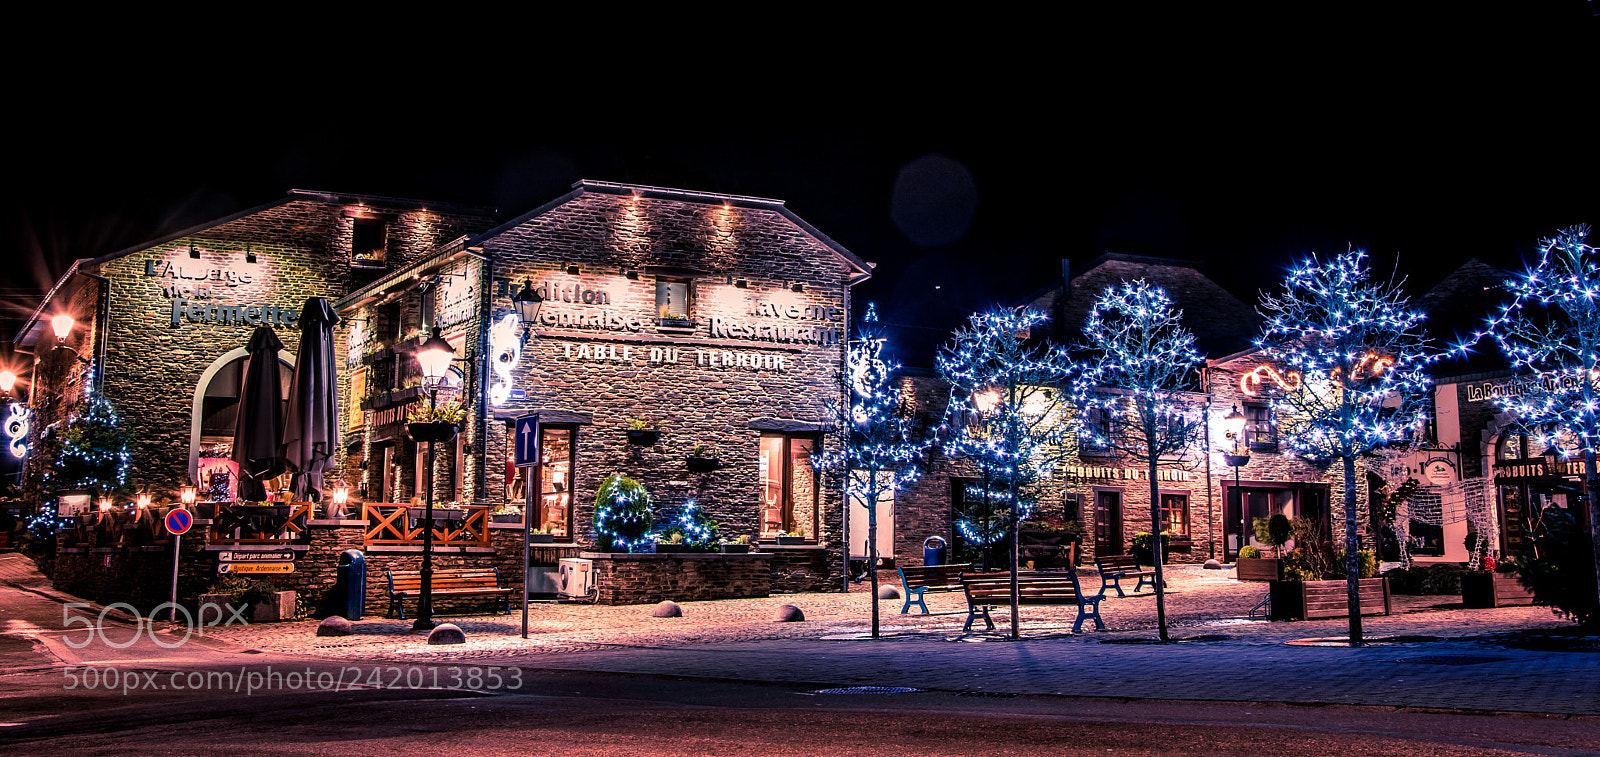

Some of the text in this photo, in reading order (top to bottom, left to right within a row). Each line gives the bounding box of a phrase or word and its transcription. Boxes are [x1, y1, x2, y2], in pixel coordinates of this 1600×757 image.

[493, 278, 611, 304] Trdition
[171, 298, 297, 328] Fermette
[747, 296, 839, 320] Taverne
[710, 315, 840, 345] Restaurant
[562, 343, 785, 370] TABLE DU TERROIR
[1467, 384, 1483, 402] La
[1125, 469, 1140, 480] DU
[1143, 469, 1189, 481] TRROIR
